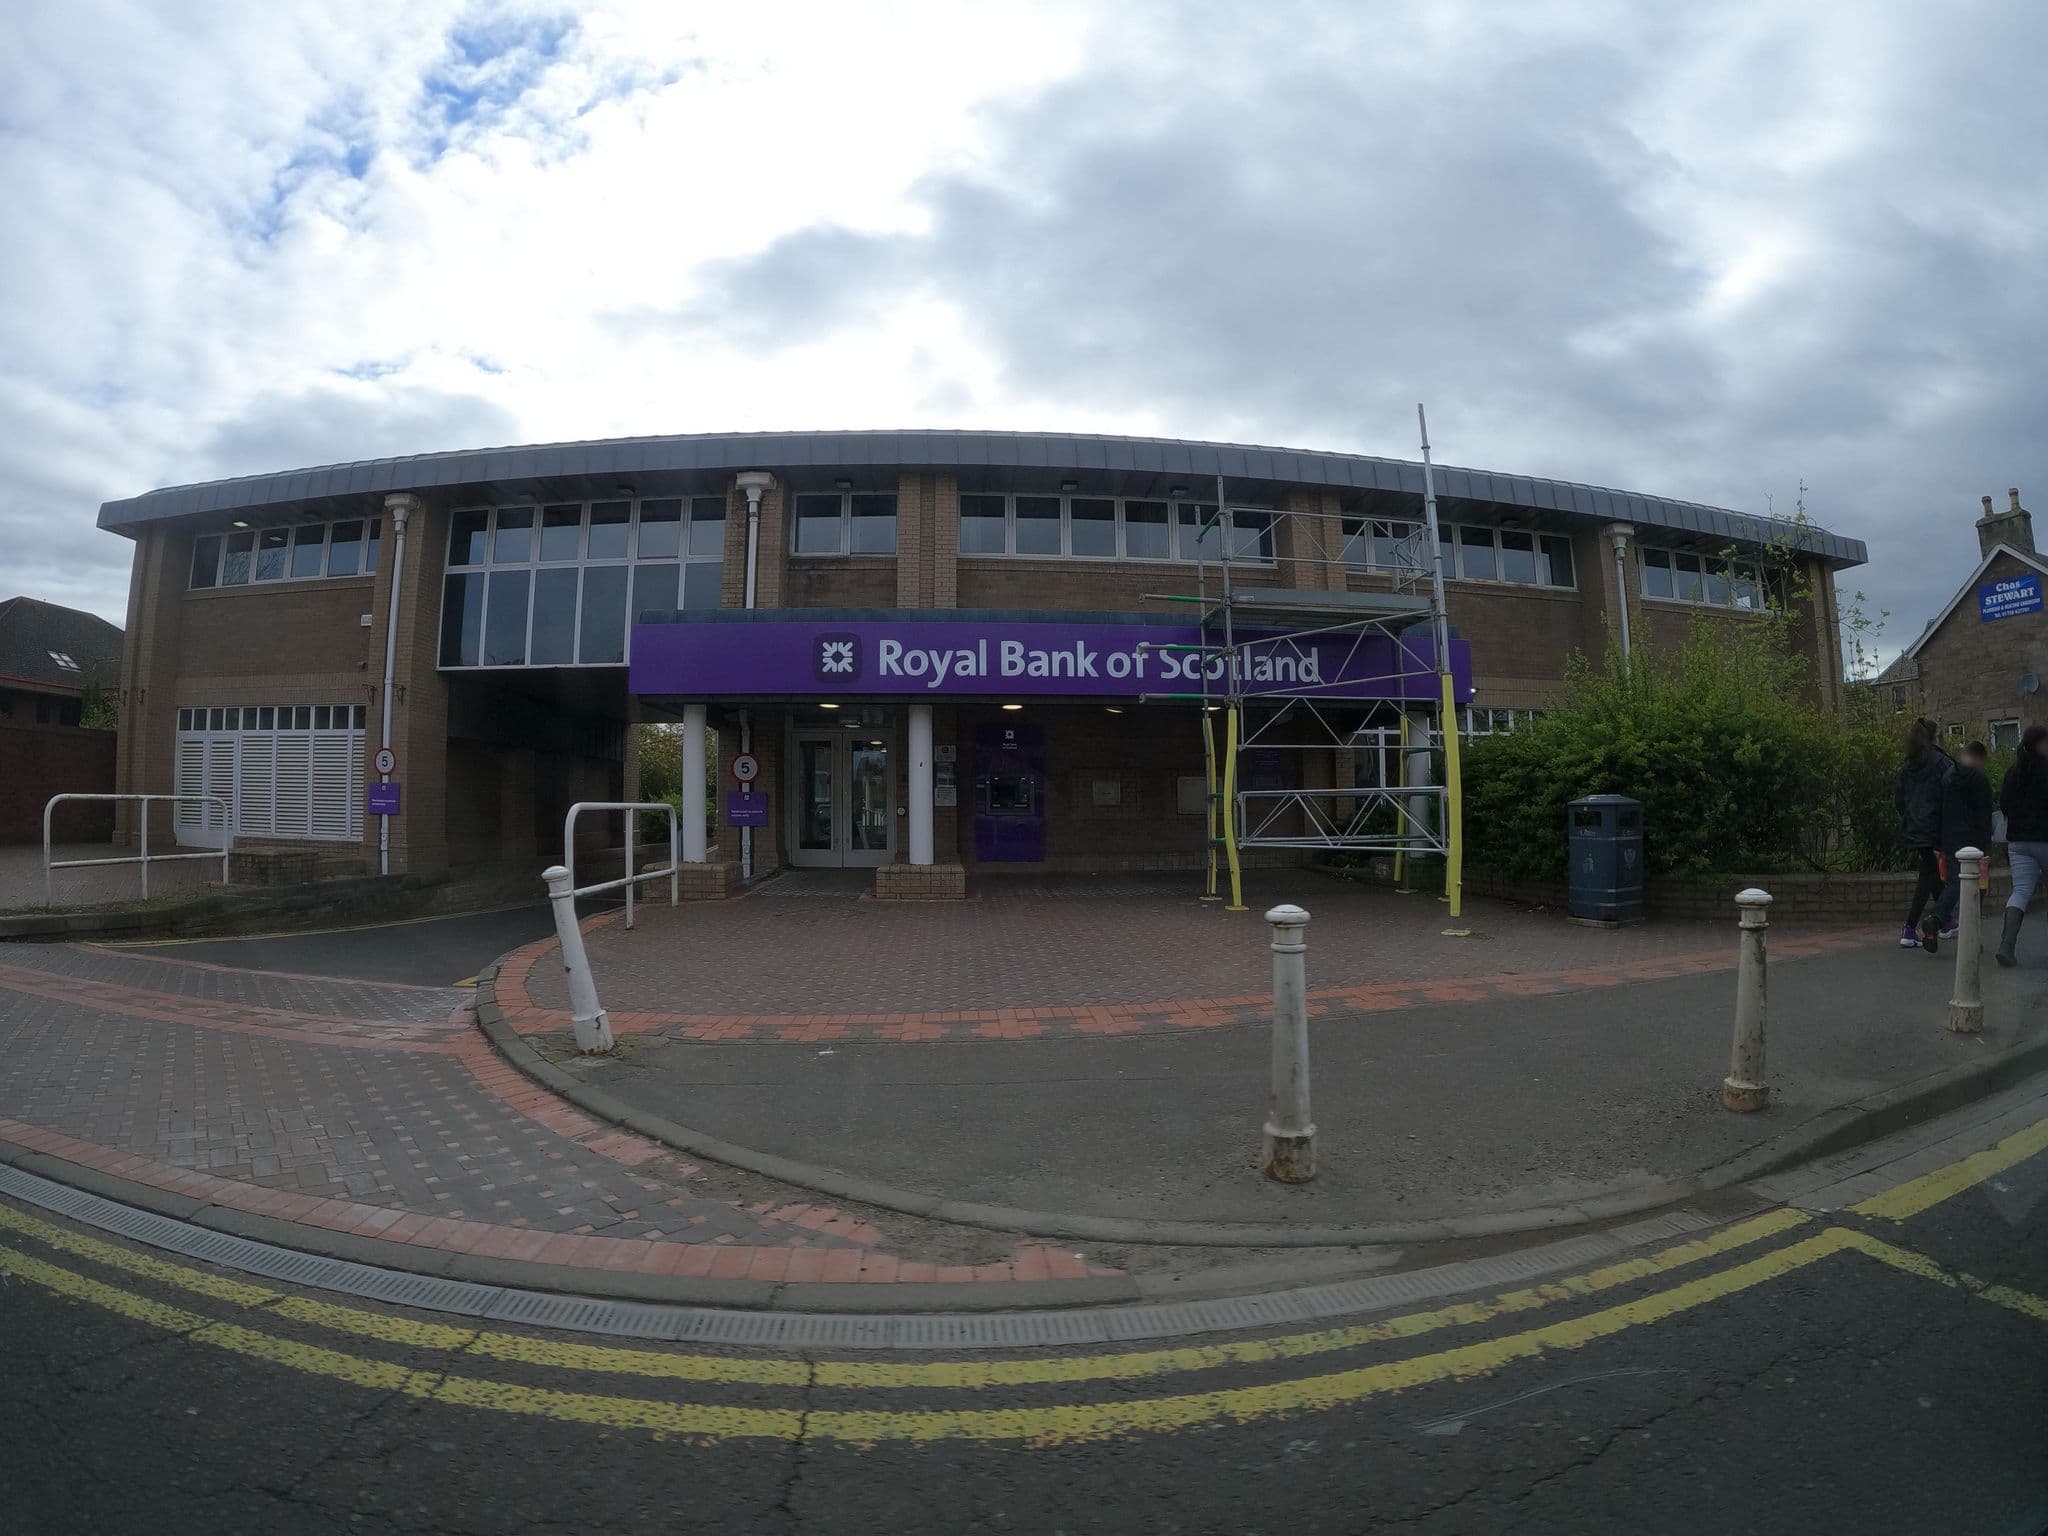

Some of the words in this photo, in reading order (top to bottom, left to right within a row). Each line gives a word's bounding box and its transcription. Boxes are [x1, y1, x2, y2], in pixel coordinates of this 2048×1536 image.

[1996, 580, 2020, 592] Chas
[1985, 587, 2034, 605] STEWART
[879, 639, 988, 688] Royal
[1000, 640, 1099, 677] Bank
[1106, 641, 1149, 678] of
[382, 755, 389, 767] 5
[741, 762, 750, 774] 5
